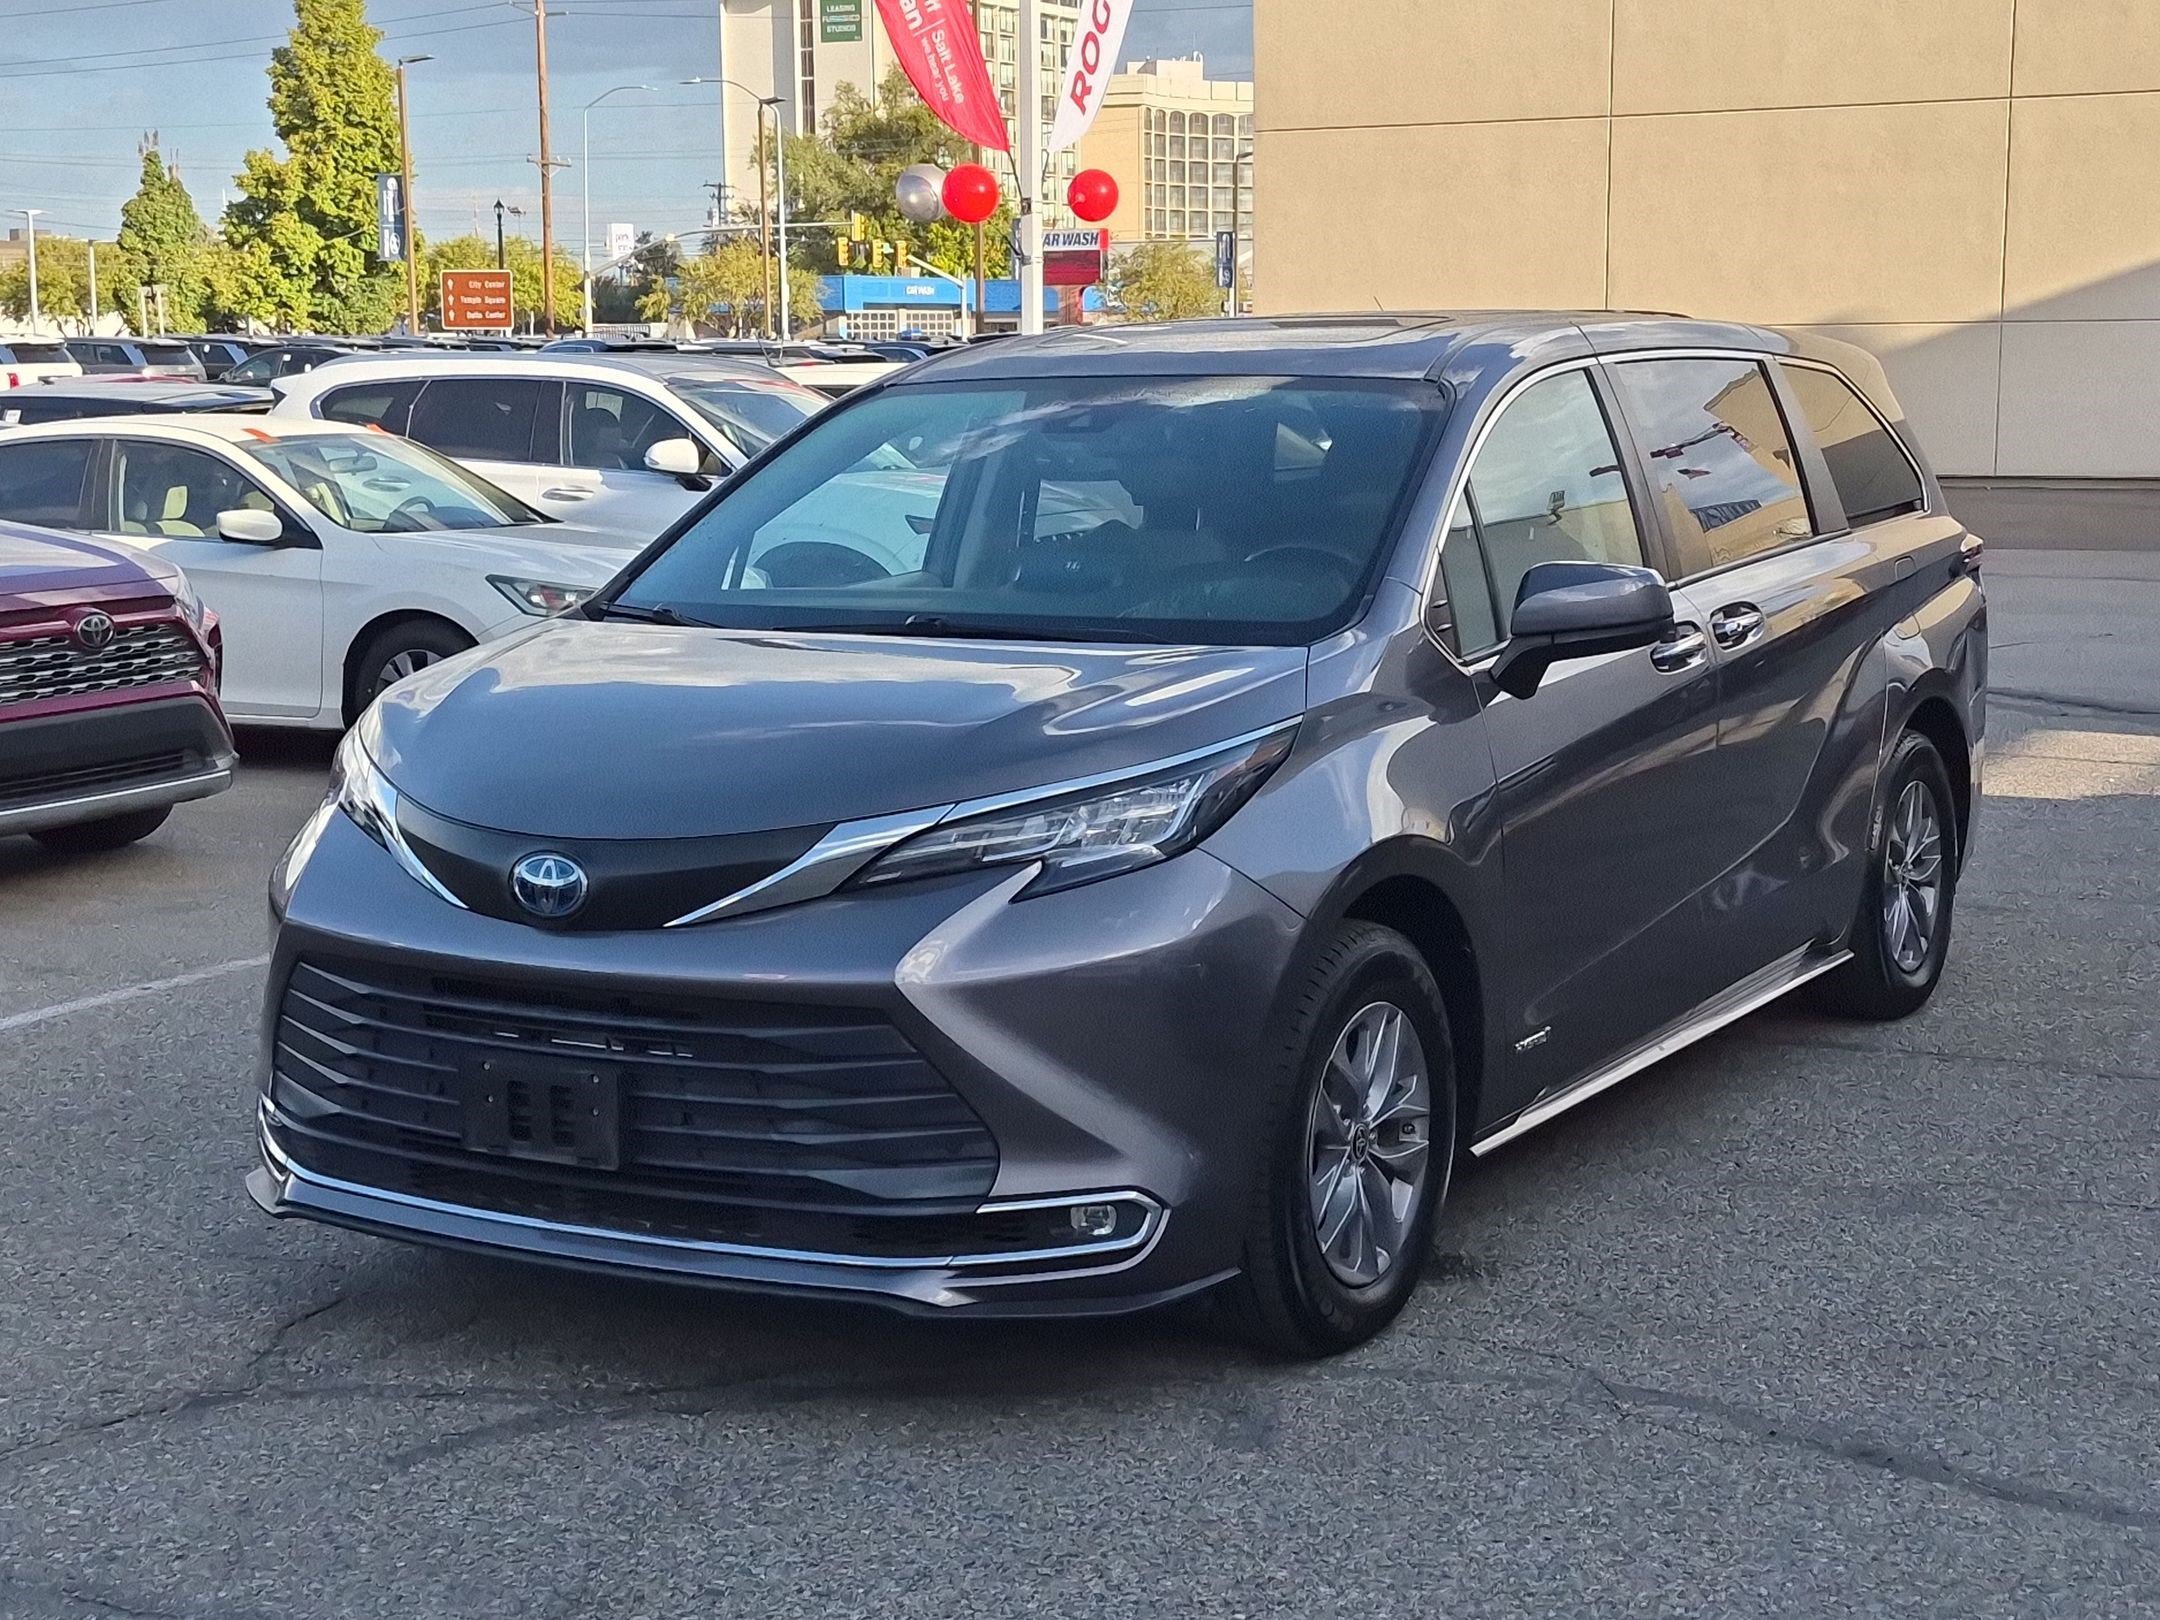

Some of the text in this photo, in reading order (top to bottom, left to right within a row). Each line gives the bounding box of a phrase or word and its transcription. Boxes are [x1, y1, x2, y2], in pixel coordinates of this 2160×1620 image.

[921, 37, 932, 55] we
[934, 79, 949, 102] you
[931, 29, 952, 64] Salt
[944, 63, 965, 104] Lake
[1042, 232, 1099, 248] AR WASH
[468, 280, 505, 289] City Center
